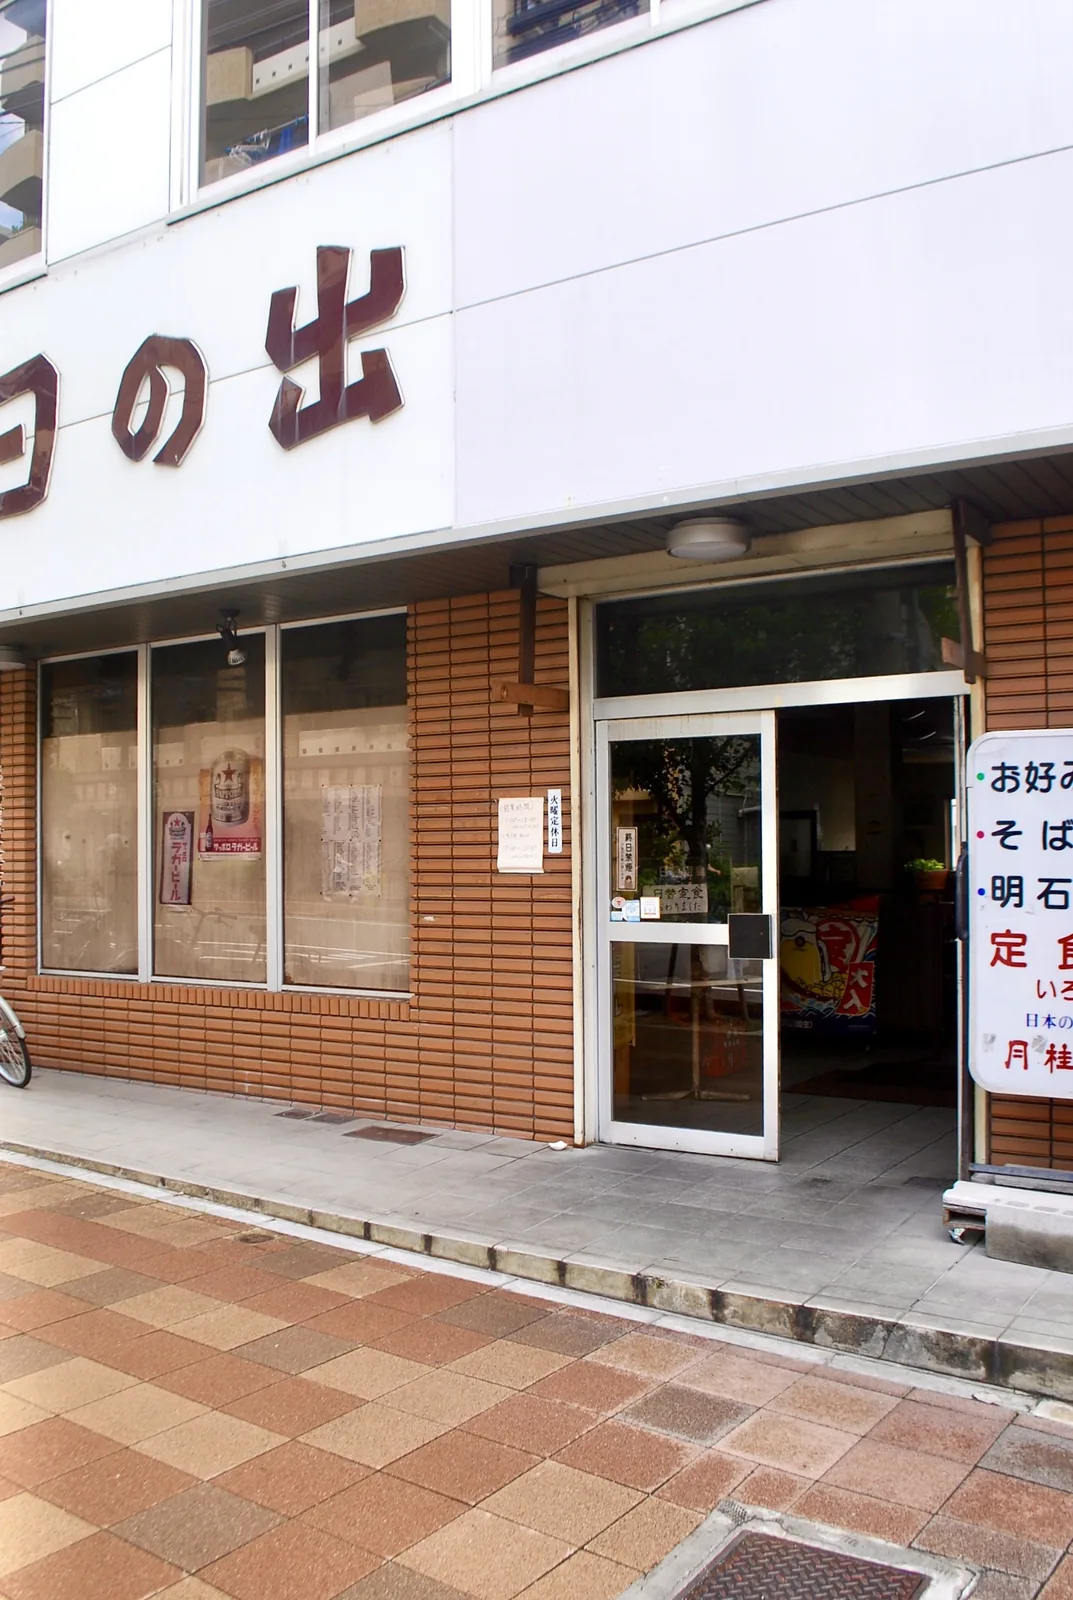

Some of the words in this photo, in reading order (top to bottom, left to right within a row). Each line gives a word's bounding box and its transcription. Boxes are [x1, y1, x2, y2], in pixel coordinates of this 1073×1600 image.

[549, 795, 560, 847] 火曜定休日
[170, 841, 182, 901] ラガービール
[991, 875, 1073, 909] 明石
[843, 967, 869, 1014] 大入
[1026, 1013, 1073, 1029] 日本の
[1004, 1040, 1073, 1074] 月桂
